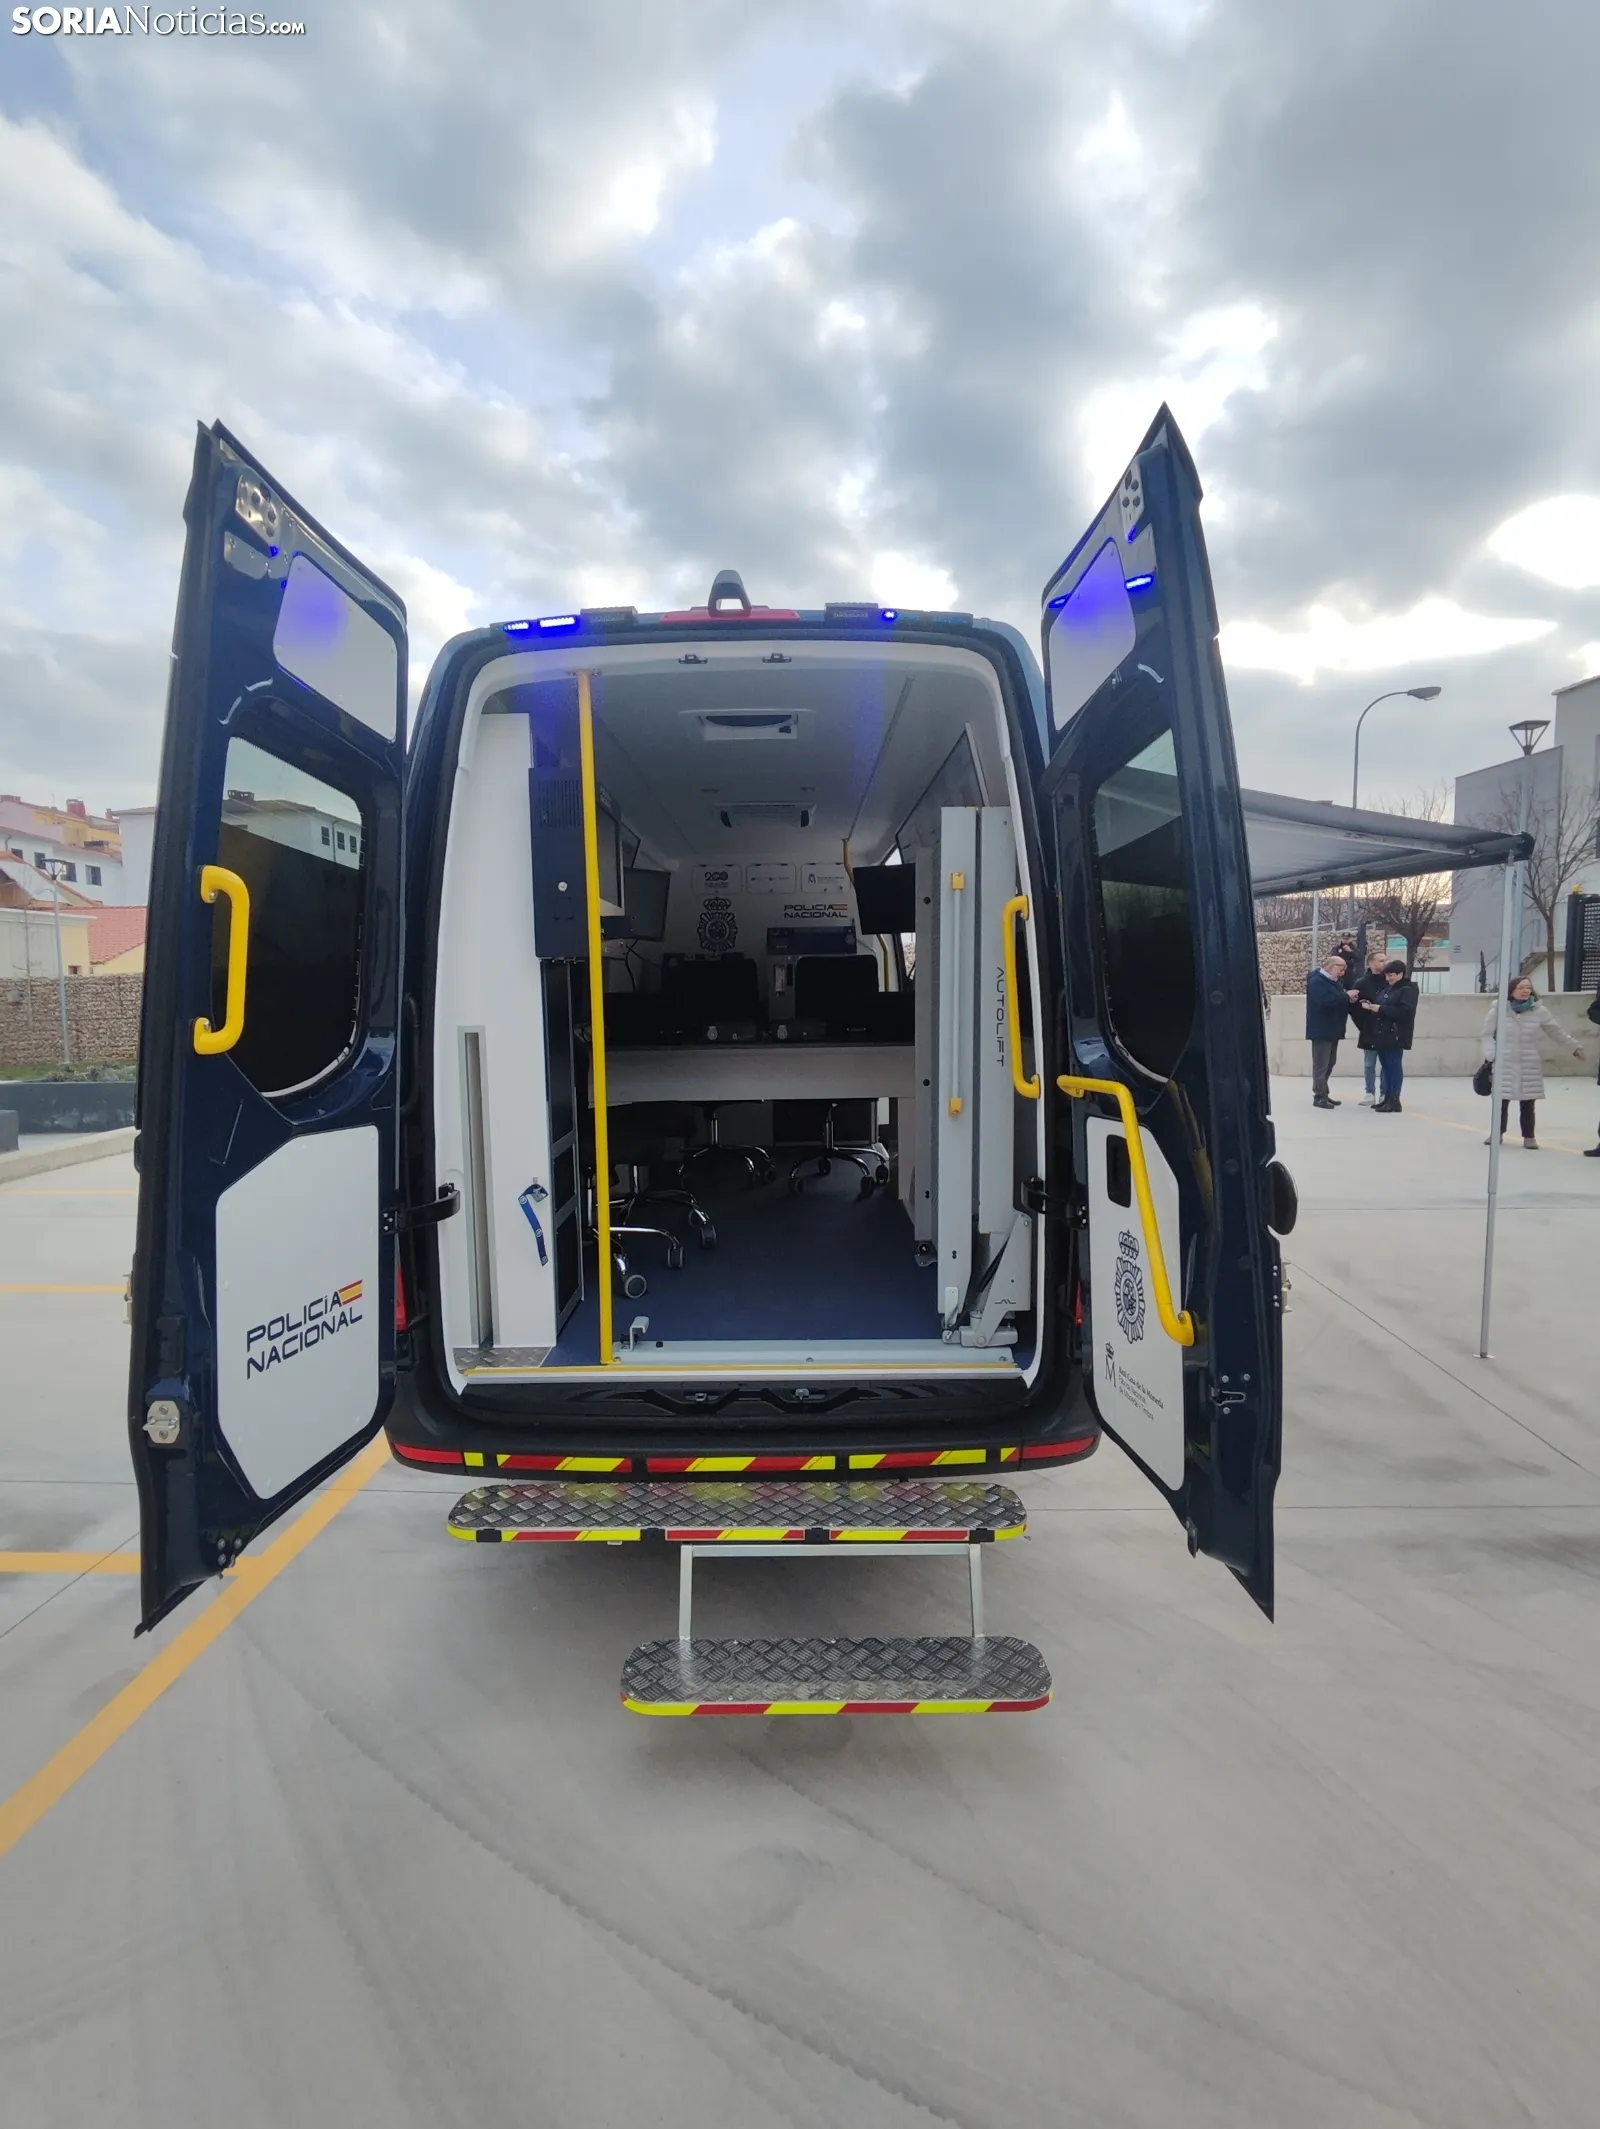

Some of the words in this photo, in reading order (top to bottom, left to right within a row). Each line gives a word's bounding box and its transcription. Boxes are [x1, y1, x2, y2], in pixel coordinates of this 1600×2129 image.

[783, 911, 848, 919] NACIONAL
[996, 966, 1005, 1068] AUTOLIFT
[246, 1306, 363, 1380] NACIONAL
